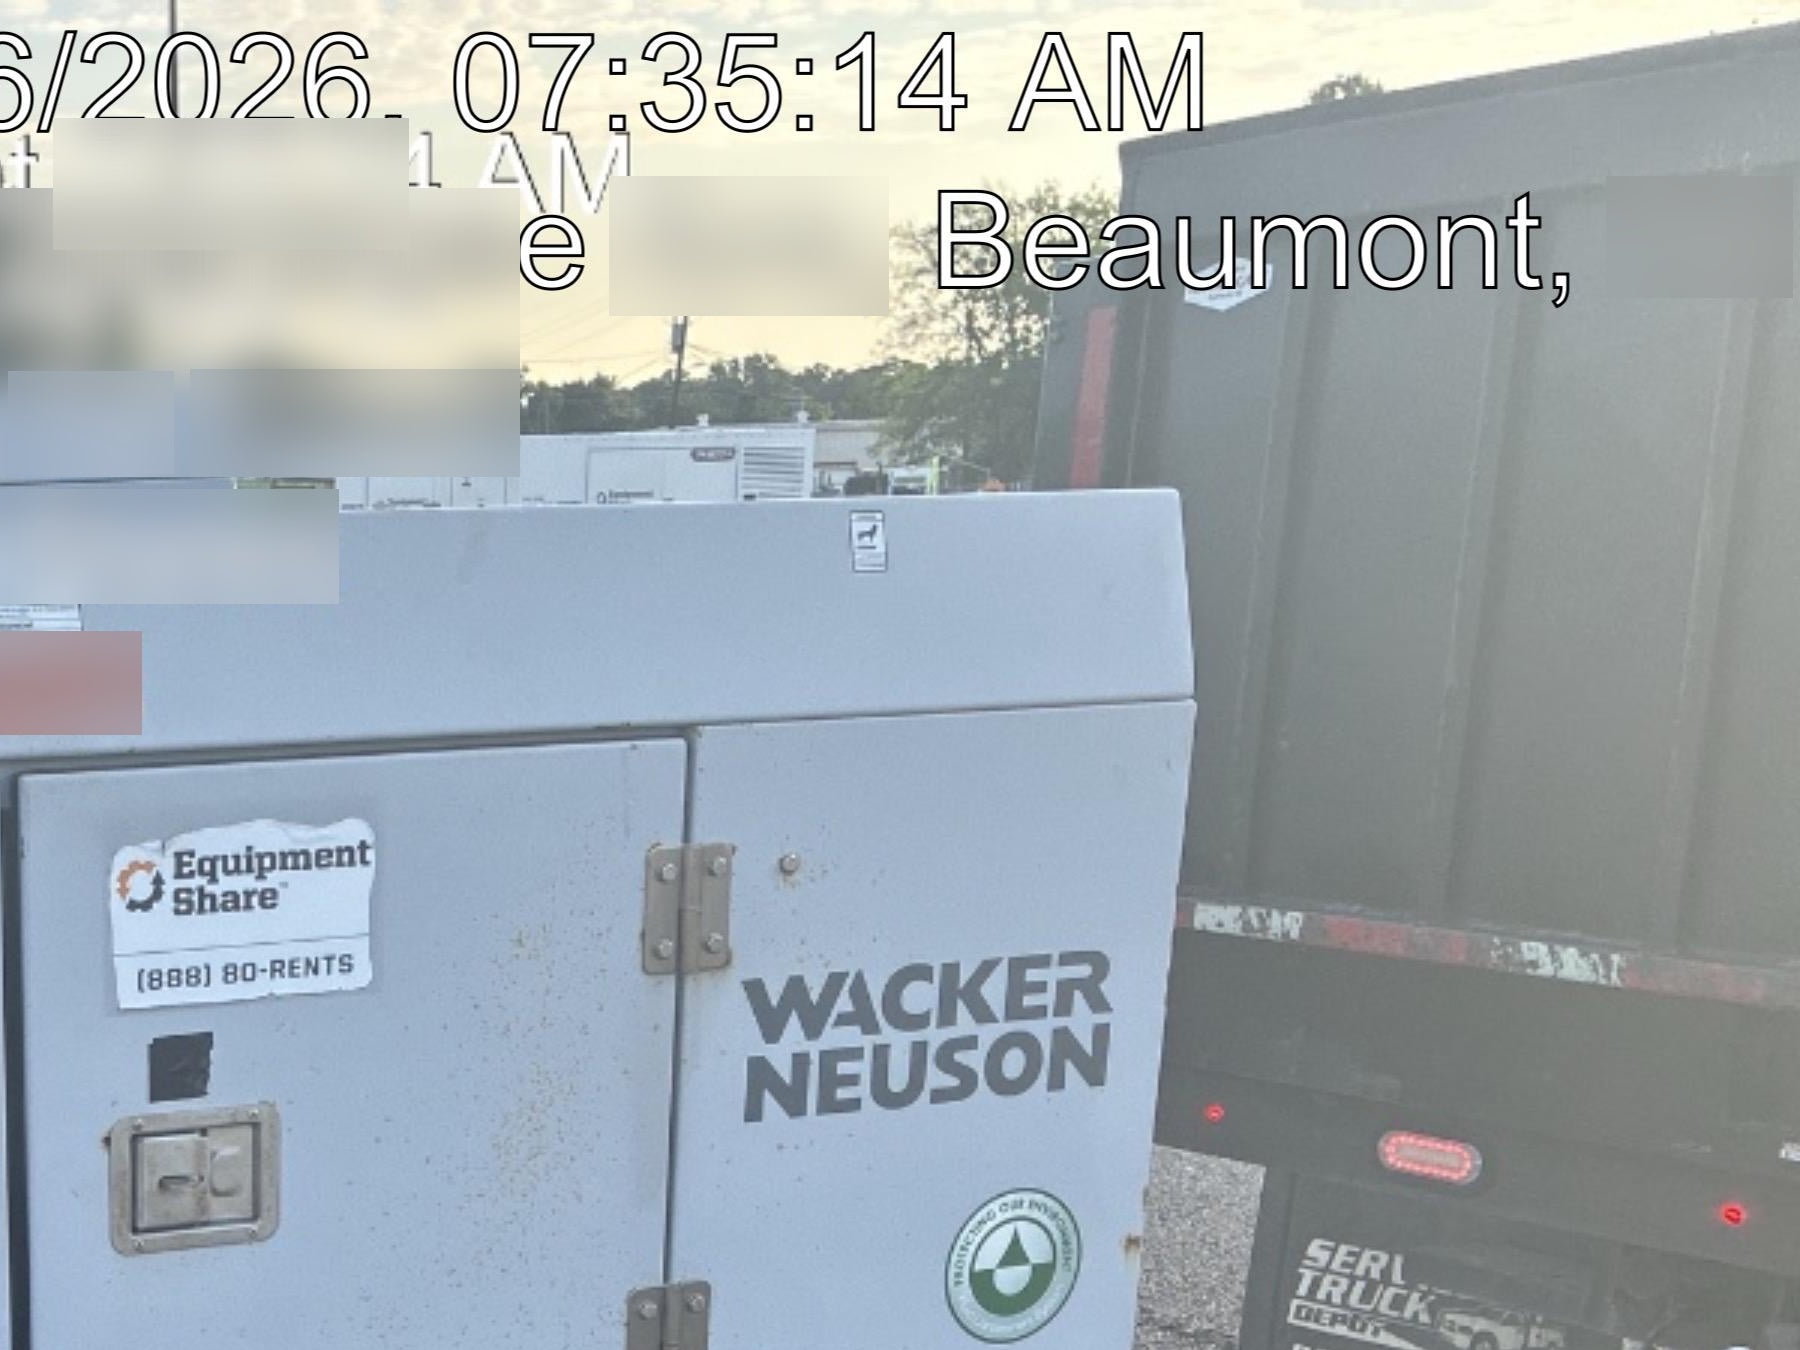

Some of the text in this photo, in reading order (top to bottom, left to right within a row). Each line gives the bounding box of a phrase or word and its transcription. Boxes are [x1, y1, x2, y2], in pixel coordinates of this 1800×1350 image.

[173, 840, 372, 884] Equipment
[173, 886, 280, 916] Share
[137, 953, 355, 993] (888) 80-RENTS
[741, 950, 1113, 1045] WACKER
[744, 1022, 1111, 1123] NEUSON
[1296, 1267, 1436, 1325] TRUCK
